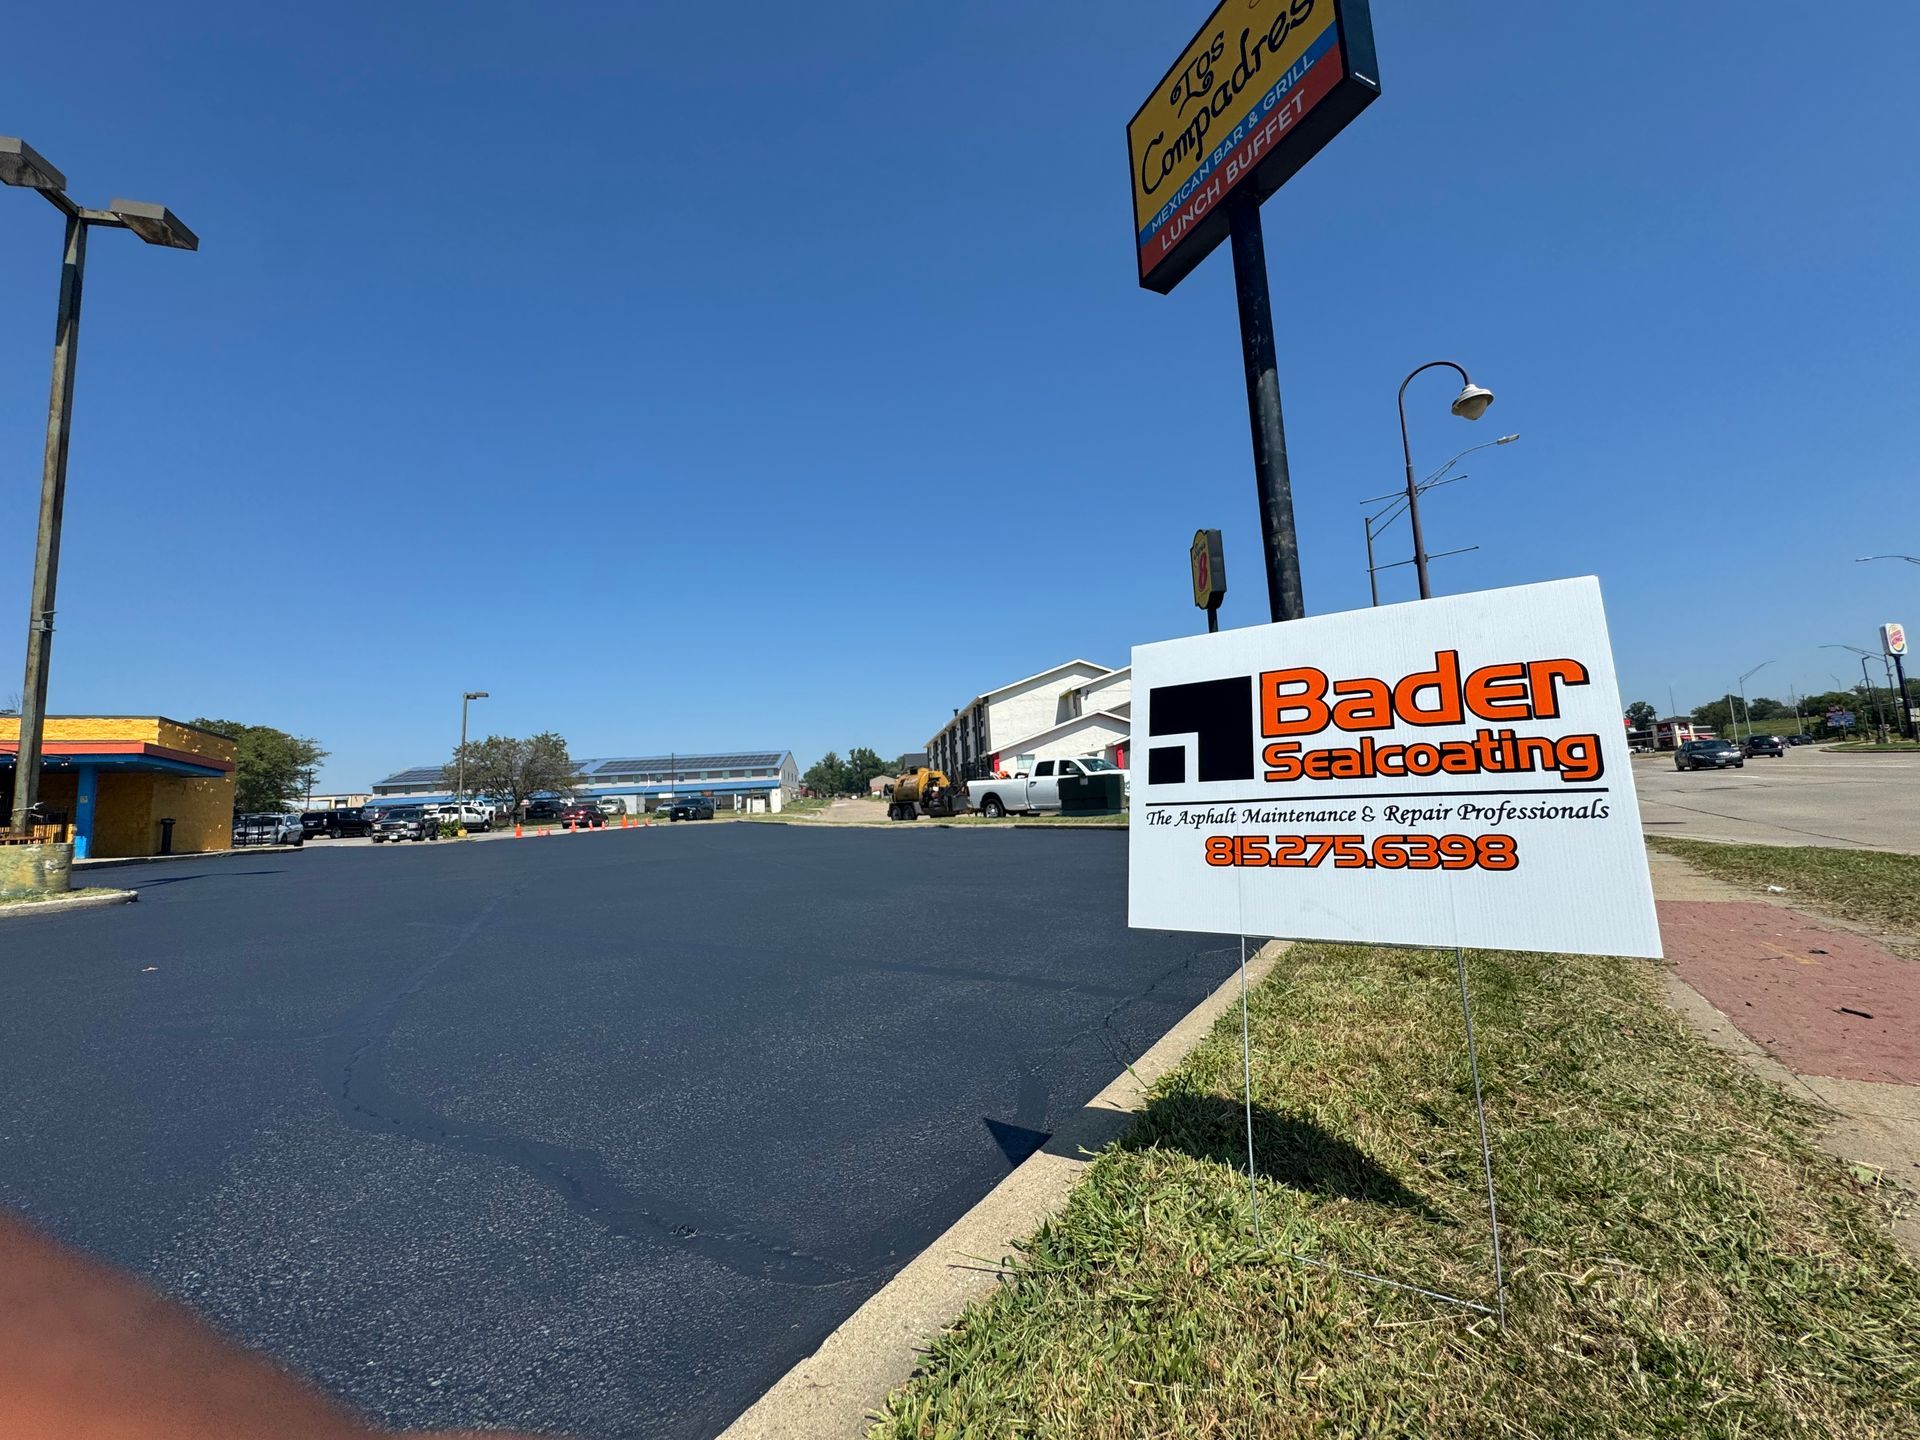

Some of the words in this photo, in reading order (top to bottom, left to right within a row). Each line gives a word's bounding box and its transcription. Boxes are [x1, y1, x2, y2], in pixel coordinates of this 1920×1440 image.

[1142, 0, 1314, 194] Compadres
[1170, 30, 1224, 118] Los
[1151, 161, 1210, 233] MEXICAN
[1213, 125, 1243, 165] BAR
[1248, 111, 1258, 128] &
[1263, 55, 1315, 111] GRILL
[1161, 178, 1220, 251] LUNCH
[1226, 90, 1305, 184] BUFFET
[1259, 649, 1590, 738] Bader
[1261, 729, 1605, 783] Sealcoating
[1146, 809, 1172, 826] The
[1174, 807, 1237, 830] Asphalt
[1242, 807, 1357, 824] Maintenance
[1361, 806, 1376, 822] &
[1383, 803, 1453, 827] Repair
[1457, 798, 1610, 826] Professionals
[1205, 833, 1520, 871] 815.275.6398
